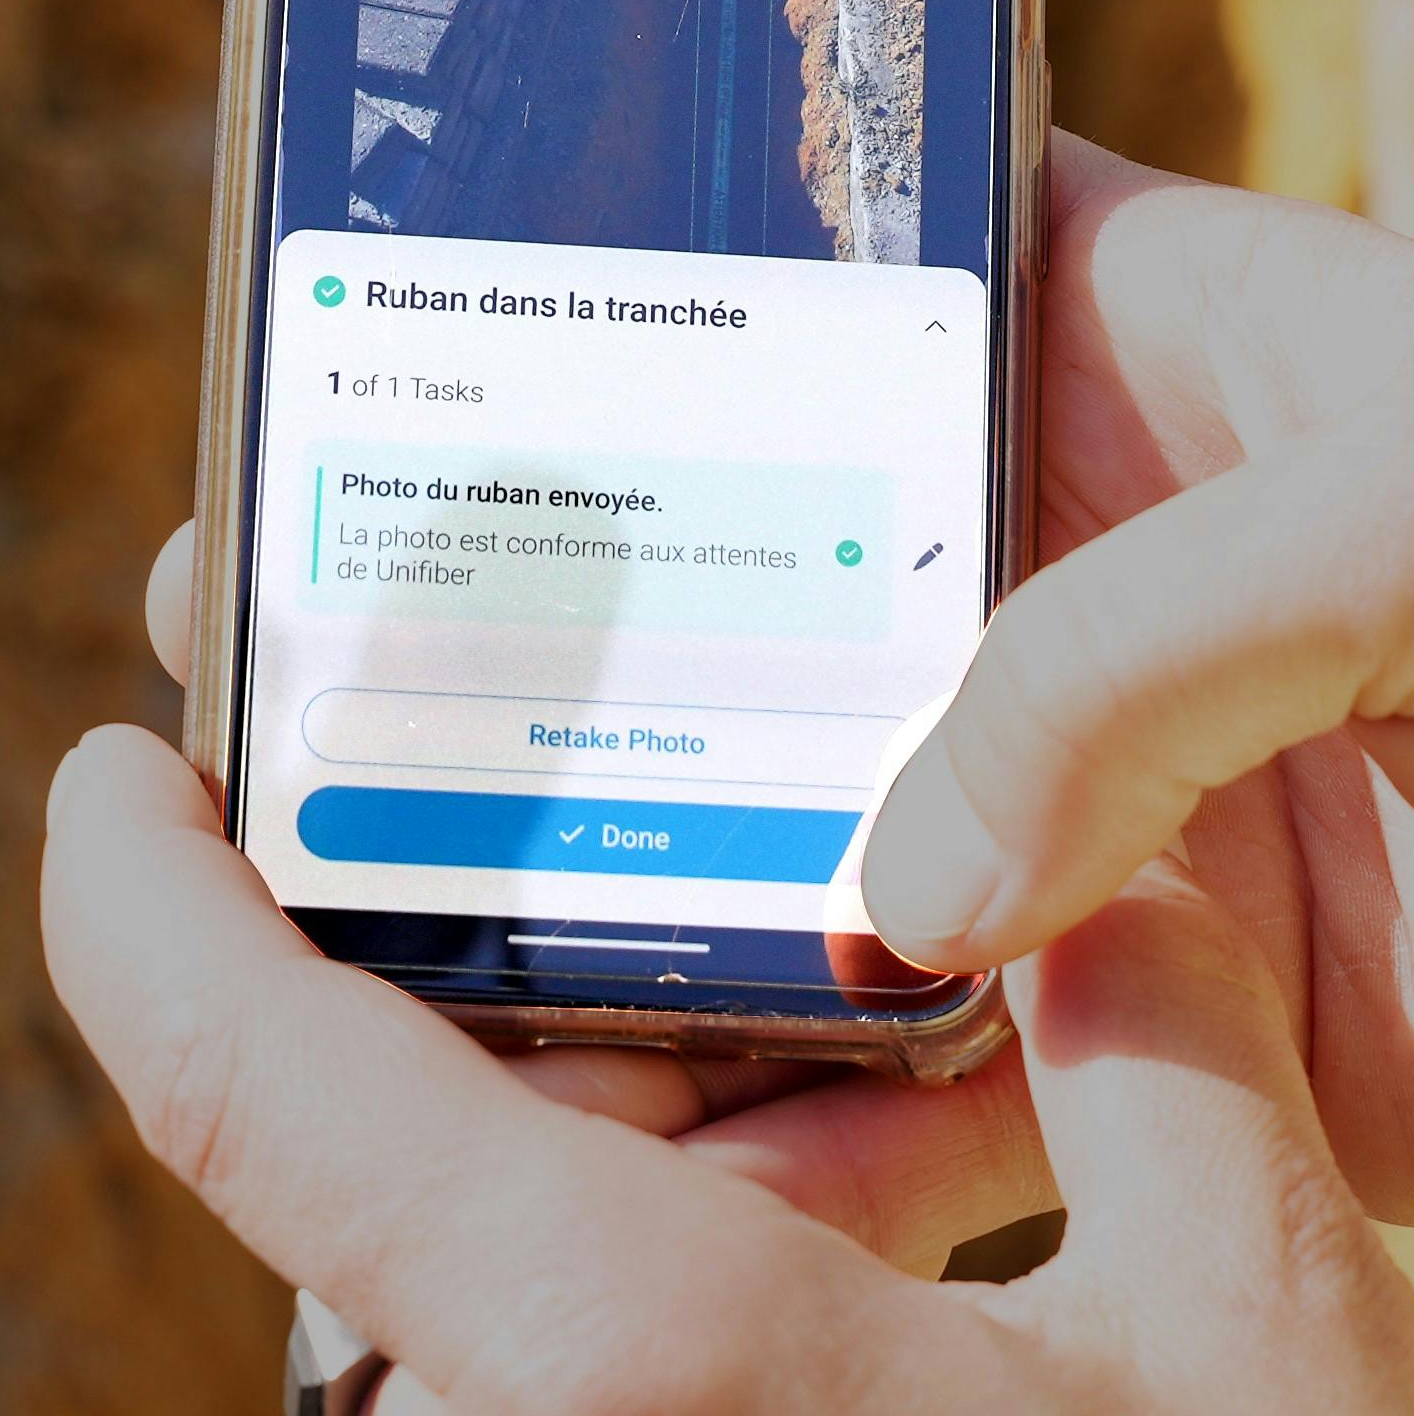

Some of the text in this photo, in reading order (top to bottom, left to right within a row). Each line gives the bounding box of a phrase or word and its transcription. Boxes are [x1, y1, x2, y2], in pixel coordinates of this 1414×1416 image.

[365, 280, 748, 330] Ruban dans la tranchée
[327, 370, 484, 404] 1 of 1 Tasks
[341, 472, 663, 516] Photo du ruban envoyée.
[339, 521, 797, 569] La photo est conforme aux attentes
[337, 556, 476, 587] de Unifiber
[528, 722, 706, 756] Retake Photo
[601, 823, 671, 852] Done
